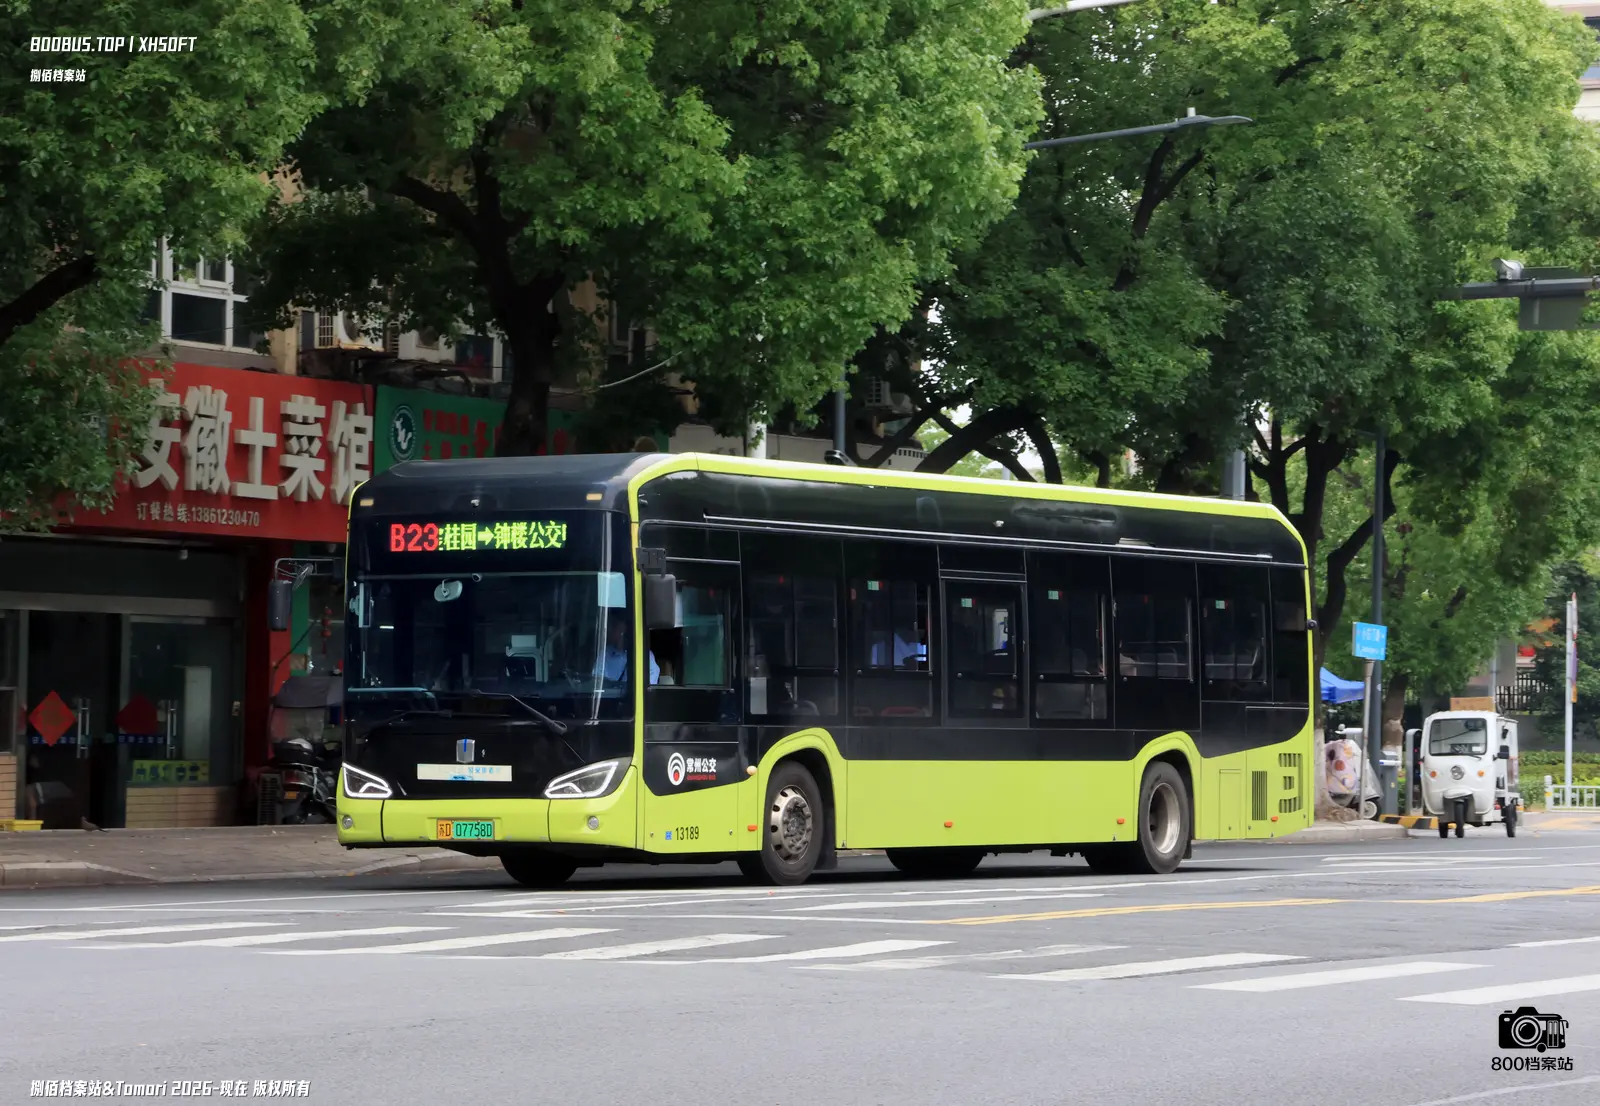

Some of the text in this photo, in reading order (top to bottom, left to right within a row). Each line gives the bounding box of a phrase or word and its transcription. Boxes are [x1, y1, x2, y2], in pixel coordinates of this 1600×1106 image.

[131, 378, 374, 505] 安徽土菜馆
[390, 520, 567, 552] B23 桂园 钟楼公交
[686, 757, 717, 773] 常州公交
[675, 825, 700, 841] 13189
